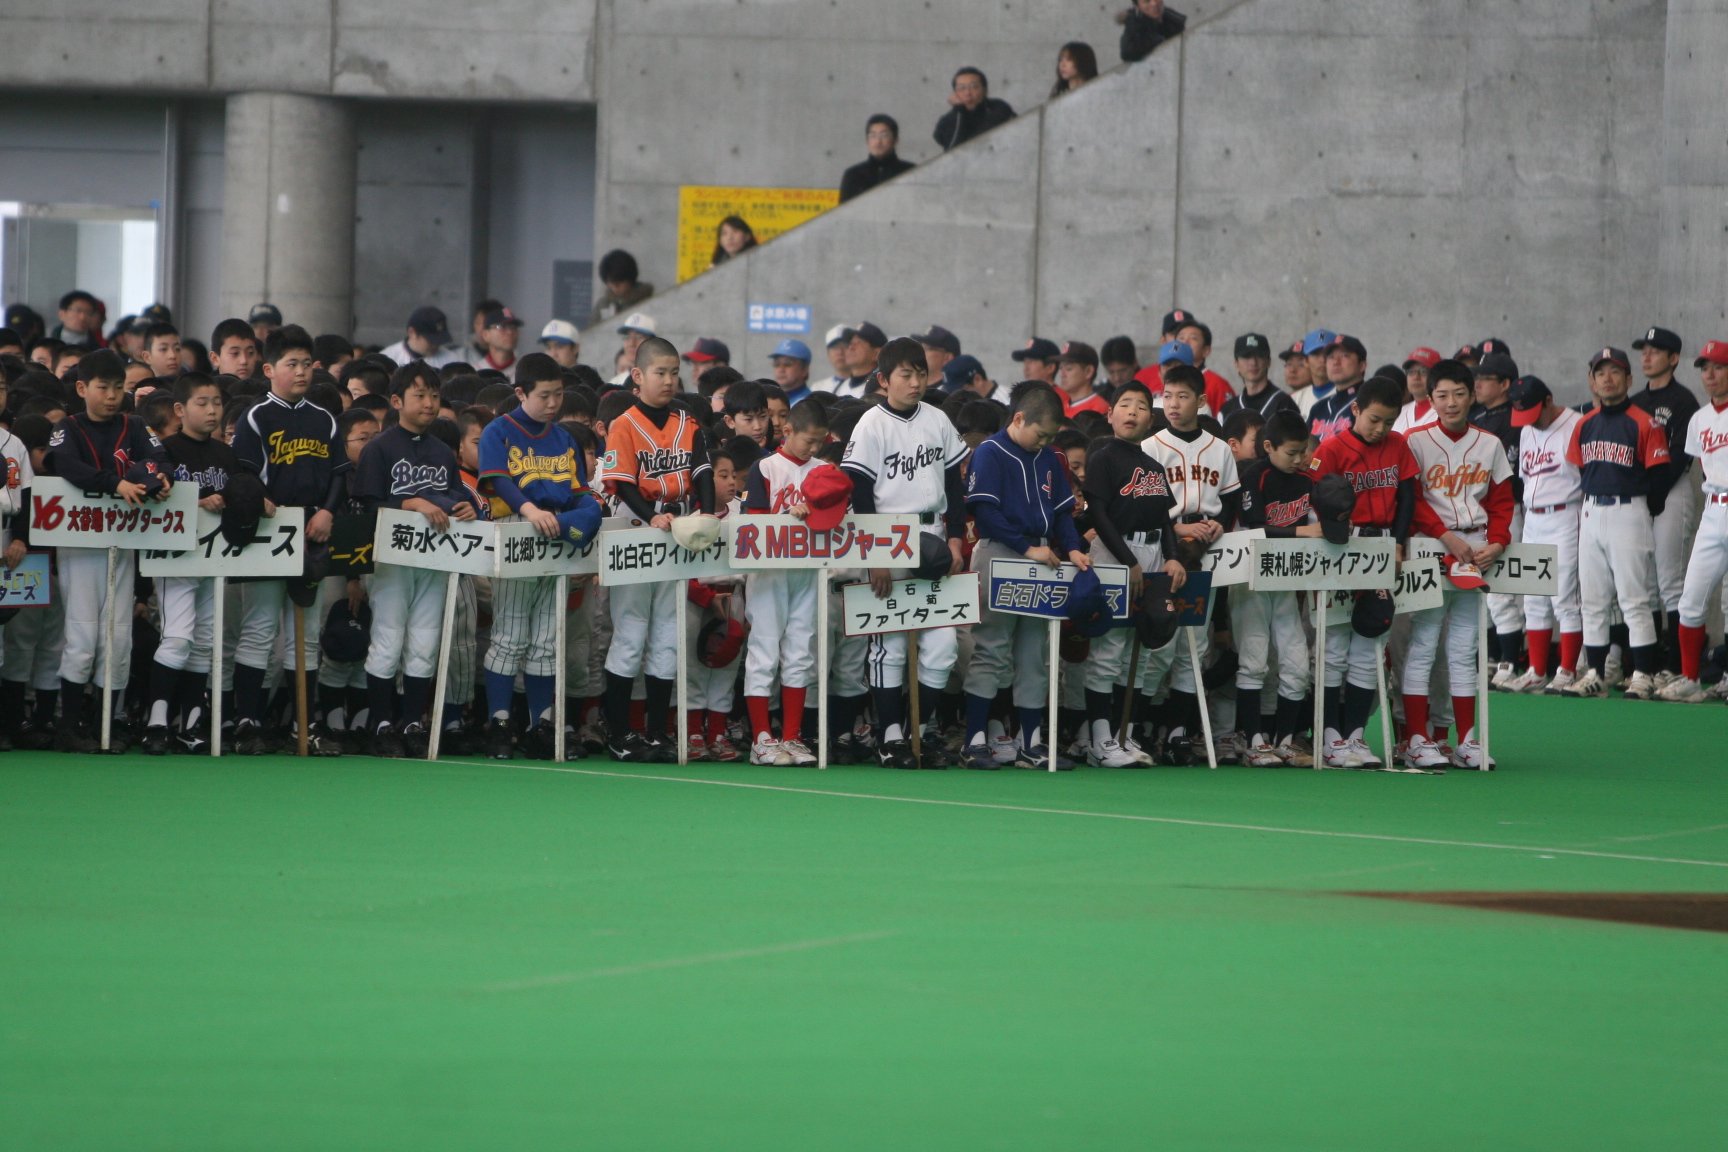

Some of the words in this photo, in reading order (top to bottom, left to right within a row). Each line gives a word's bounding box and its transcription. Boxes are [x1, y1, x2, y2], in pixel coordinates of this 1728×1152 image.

[1207, 546, 1250, 573] アン
[1259, 551, 1391, 578] 東札幌ジャイアンツ
[855, 601, 971, 629] ファイターズ
